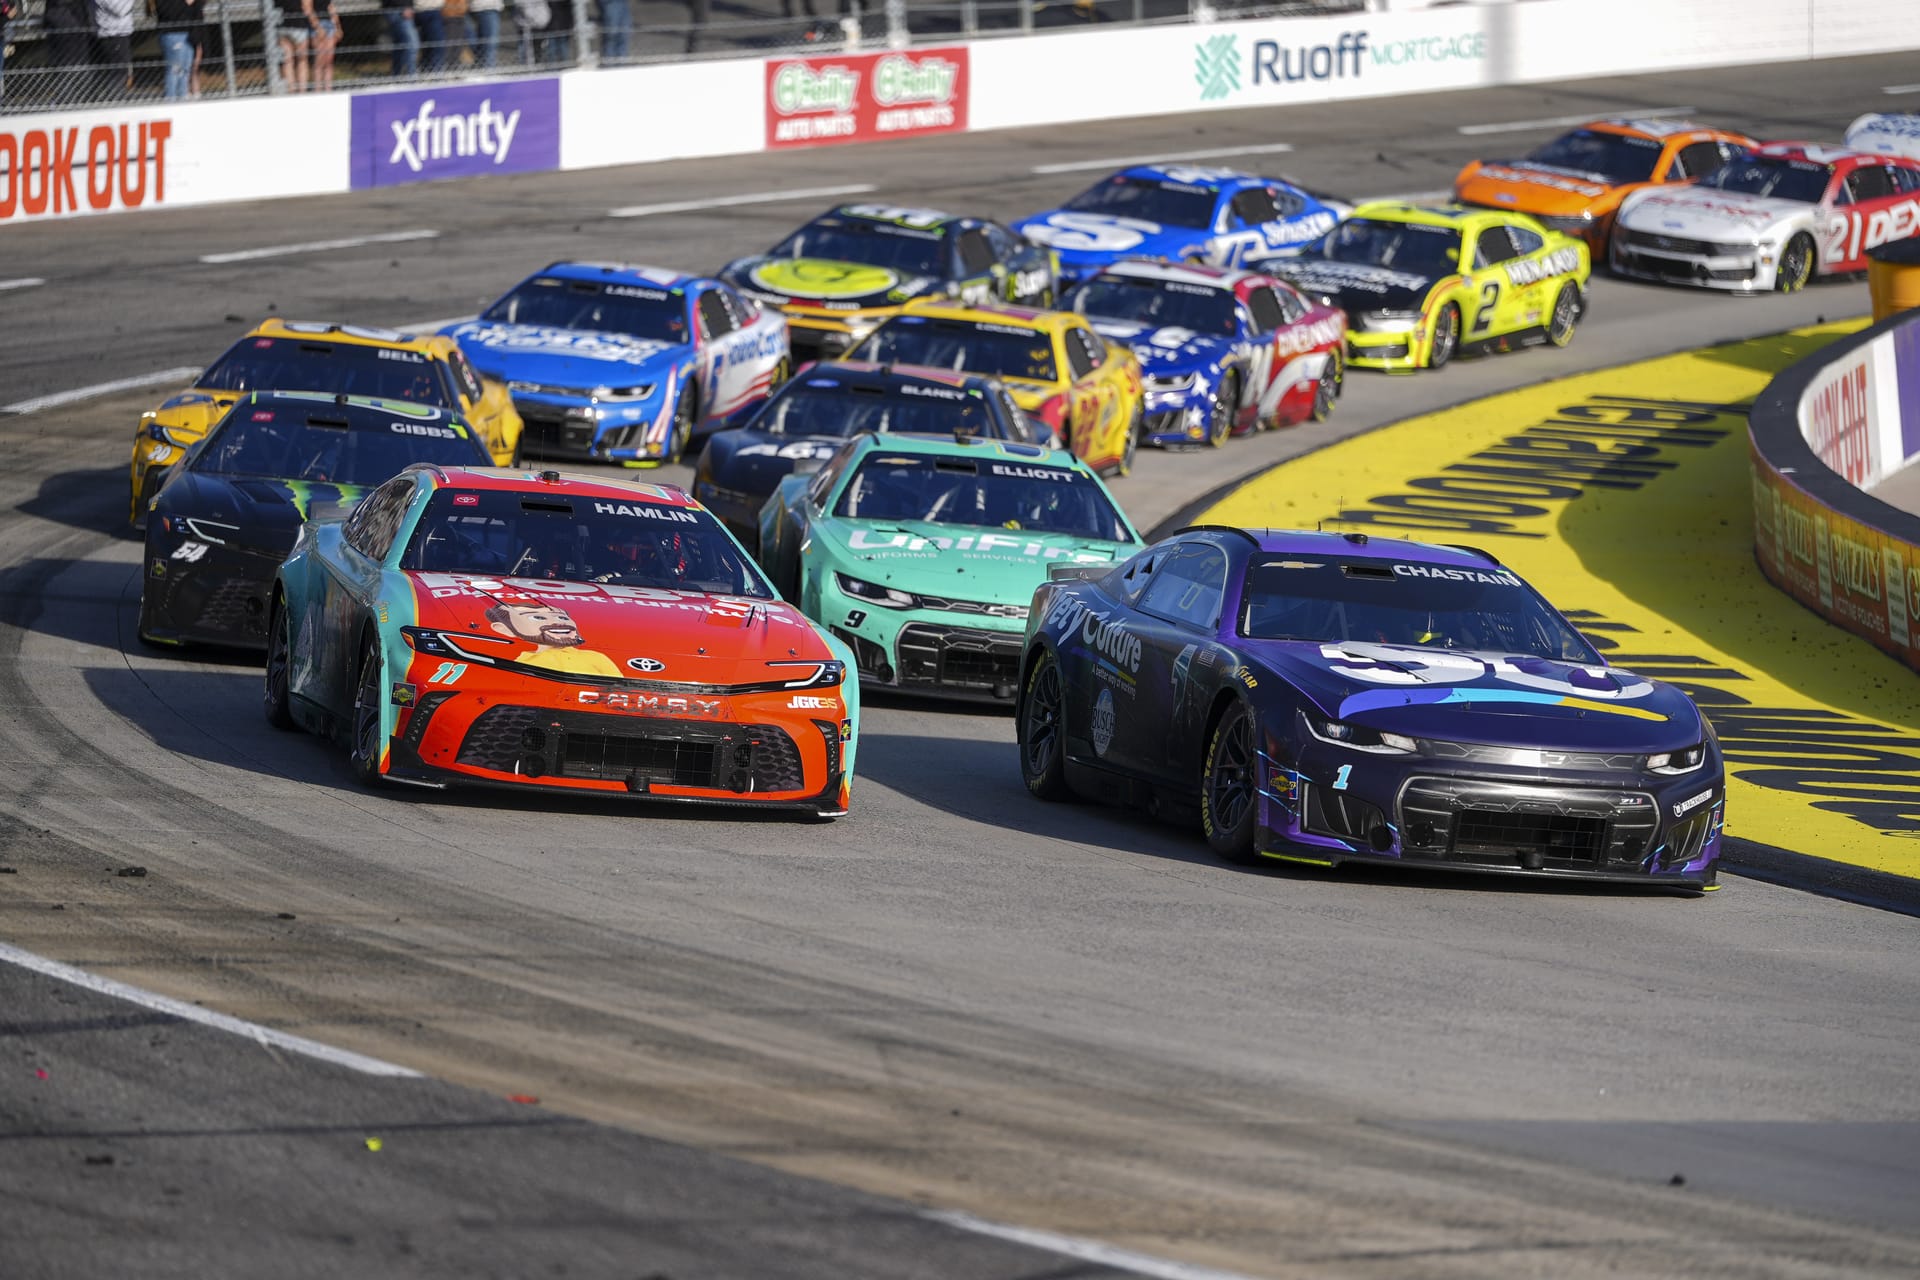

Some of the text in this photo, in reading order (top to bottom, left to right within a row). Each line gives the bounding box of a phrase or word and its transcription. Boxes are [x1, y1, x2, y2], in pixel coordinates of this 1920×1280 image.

[1252, 31, 1488, 85] Ruoff MORTGAGE
[390, 99, 521, 171] xfinity
[87, 120, 172, 210] OUT
[1825, 211, 1862, 265] 21
[605, 284, 668, 301] LARSON
[1472, 281, 1500, 335] 2
[378, 349, 424, 363] BELL
[901, 384, 966, 400] BLANEY
[391, 422, 456, 440] GIBBS
[992, 464, 1074, 483] ELLIOTT
[594, 502, 698, 524] HAMLIN
[171, 541, 210, 563] 54
[848, 530, 1132, 566] UniFir
[962, 553, 1038, 565] SERVICES
[1393, 564, 1519, 587] CHASTAIN
[1830, 532, 1881, 602] GRIZZLY
[431, 587, 608, 603] Discount
[844, 610, 867, 628] 9
[428, 662, 468, 685] 11
[578, 689, 721, 714] CAMRY
[1332, 764, 1353, 790] 1
